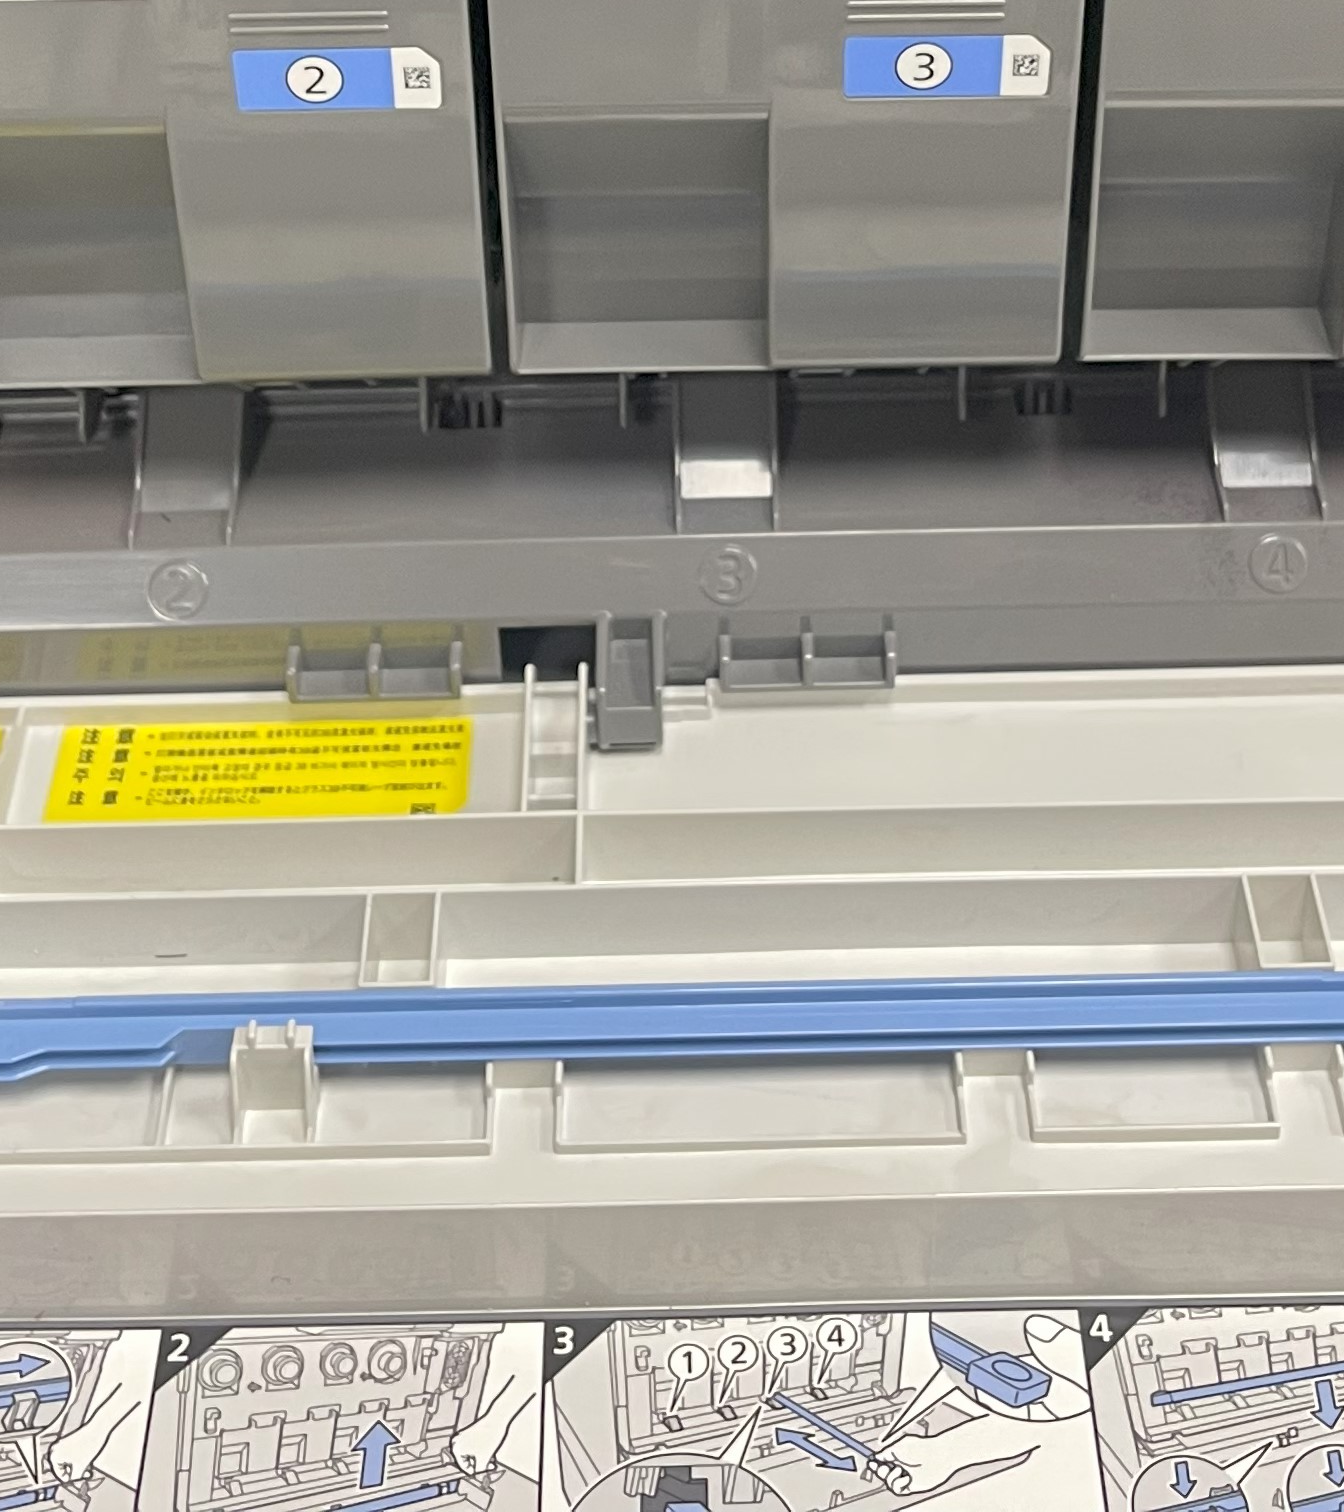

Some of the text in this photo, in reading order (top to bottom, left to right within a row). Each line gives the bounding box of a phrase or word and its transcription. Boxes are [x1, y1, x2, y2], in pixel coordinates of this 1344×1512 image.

[828, 1325, 845, 1347] 4
[1089, 1314, 1114, 1342] 4
[167, 1333, 190, 1362] 2
[552, 1329, 575, 1355] 3
[731, 1341, 748, 1362] 2
[781, 1332, 797, 1355] 3
